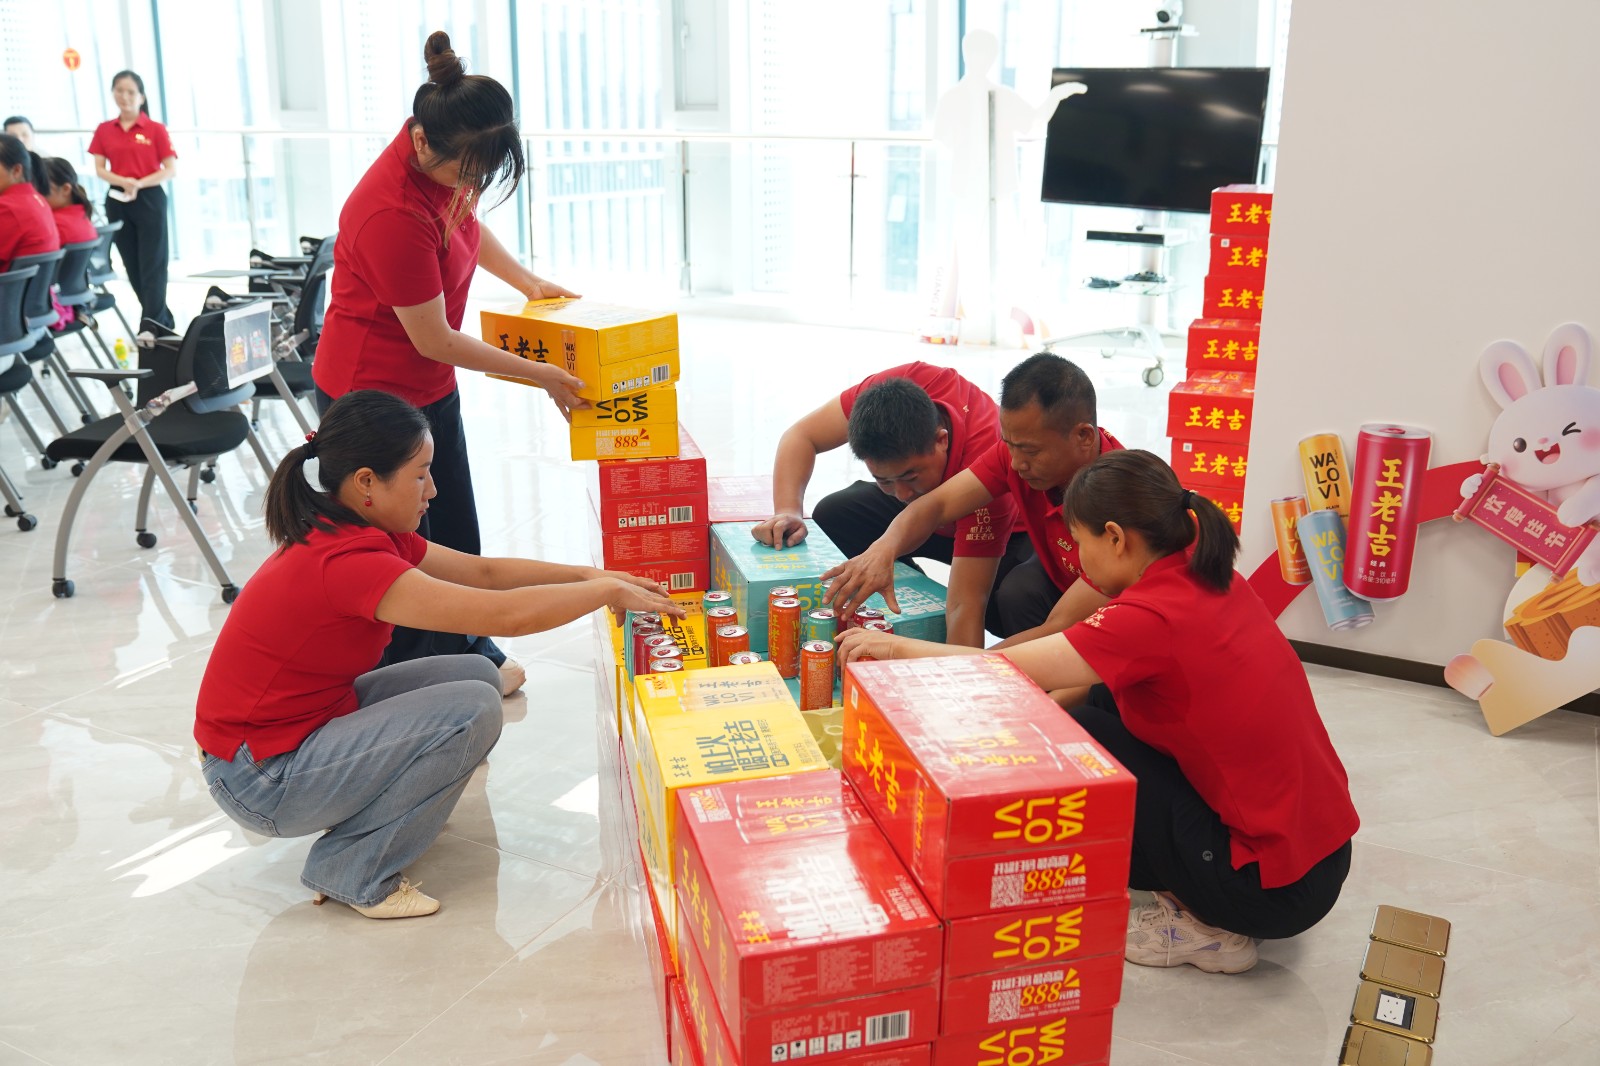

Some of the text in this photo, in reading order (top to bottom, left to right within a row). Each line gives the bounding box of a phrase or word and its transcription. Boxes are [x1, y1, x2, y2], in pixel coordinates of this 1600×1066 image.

[1203, 339, 1259, 361] 王老吉
[595, 400, 612, 420] VI
[613, 397, 631, 423] LO
[1185, 406, 1246, 430] 王老吉
[614, 435, 639, 448] 888
[1190, 452, 1248, 477] 王老吉
[1309, 451, 1337, 469] WA
[1316, 467, 1340, 484] LO
[1318, 483, 1341, 500] VI
[976, 516, 990, 524] LO
[1366, 458, 1405, 557] 王老吉
[1483, 494, 1567, 548] 欢度佳节
[1310, 529, 1340, 549] WA
[699, 679, 763, 689] 王老吉
[740, 691, 756, 702] VI
[702, 693, 720, 707] WA
[720, 692, 739, 703] LO
[696, 734, 739, 775] 怕上火
[723, 719, 770, 772] 喝王老吉
[855, 719, 900, 815] 王老吉
[756, 796, 833, 809] 王老吉
[1055, 788, 1087, 841] WA
[765, 816, 788, 836] WA
[786, 814, 809, 831] LO
[808, 813, 829, 828] VI
[993, 800, 1024, 839] VI
[1024, 796, 1055, 843] LO
[1023, 867, 1067, 892] 888
[737, 910, 771, 944] 王老吉
[993, 919, 1022, 958] VI
[1023, 915, 1053, 960] LO
[1053, 906, 1084, 957] WA
[1020, 982, 1062, 1007] 888
[978, 1030, 1006, 1066] VI
[1007, 1026, 1036, 1066] LO
[1037, 1017, 1067, 1066] WA
